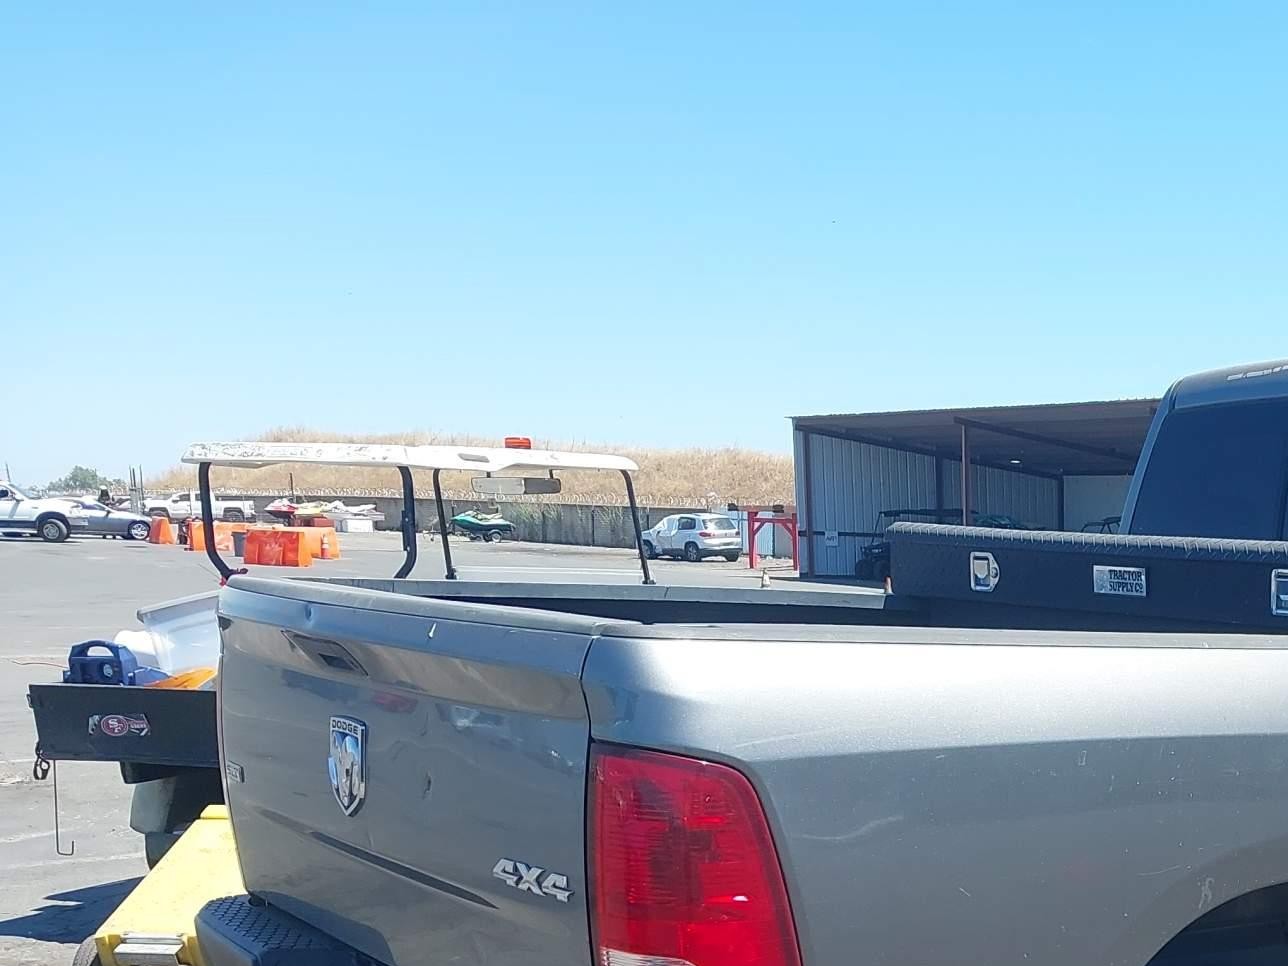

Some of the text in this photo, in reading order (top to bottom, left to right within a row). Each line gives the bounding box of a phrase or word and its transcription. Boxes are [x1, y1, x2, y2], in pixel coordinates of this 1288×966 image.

[1108, 569, 1143, 582] TRACTOR
[1108, 580, 1134, 592] SUPPLY
[108, 718, 124, 733] SF
[331, 719, 359, 735] DODGE
